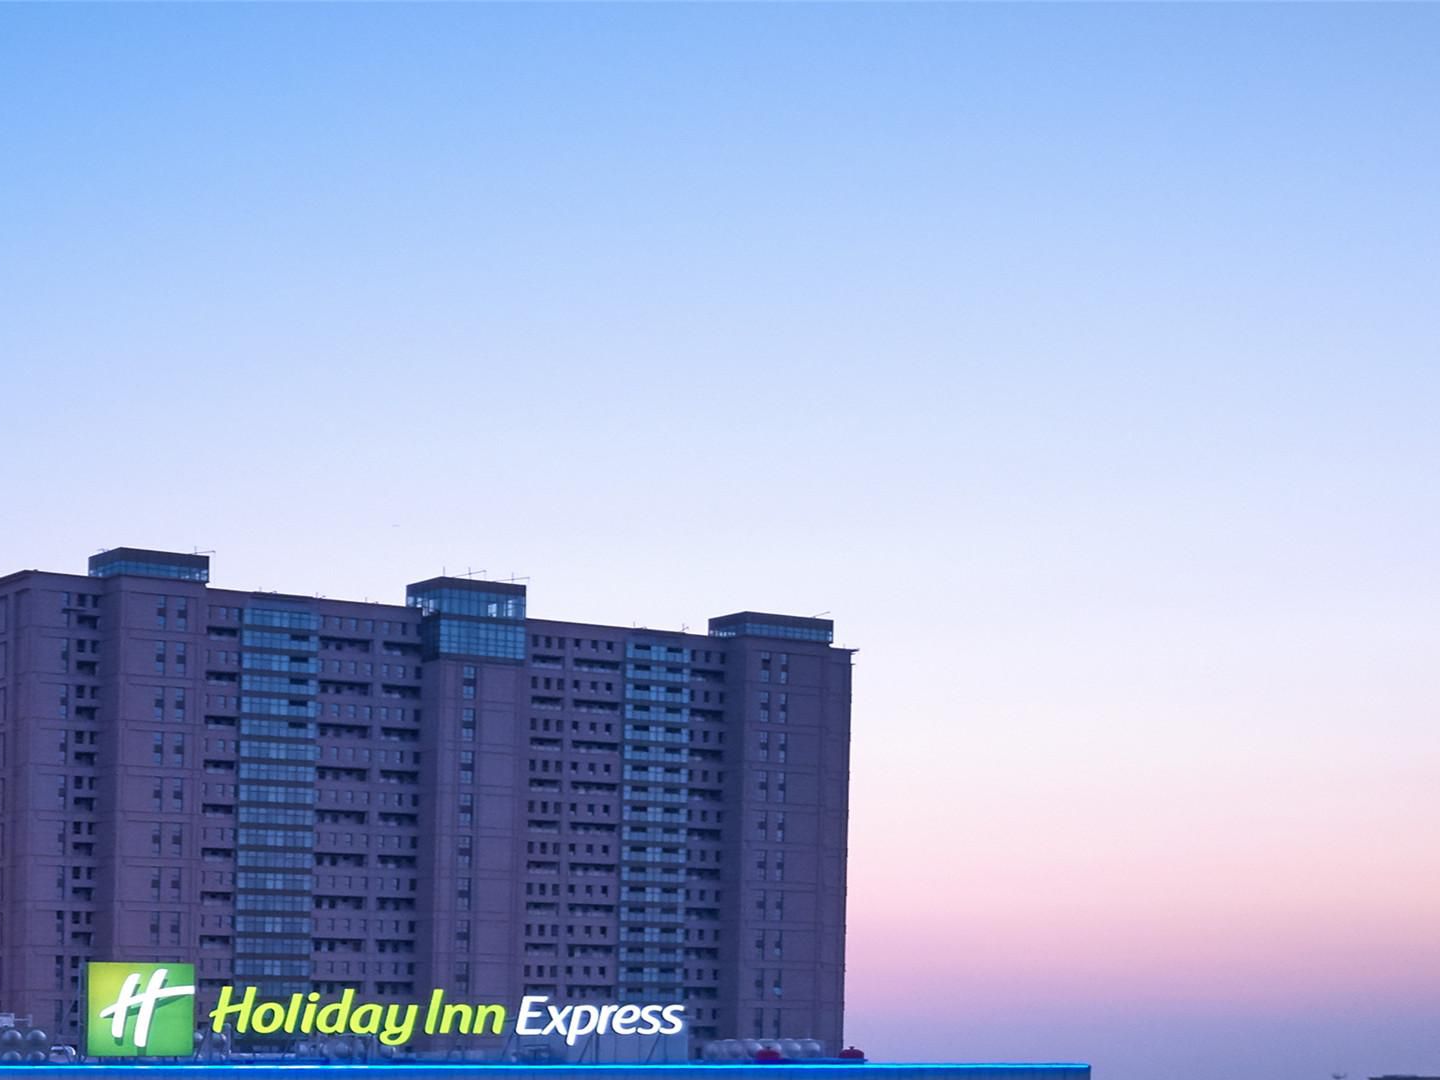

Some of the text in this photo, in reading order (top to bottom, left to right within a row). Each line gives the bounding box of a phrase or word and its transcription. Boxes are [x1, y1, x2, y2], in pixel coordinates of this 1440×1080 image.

[208, 984, 686, 1048] Holiday Inn Express
